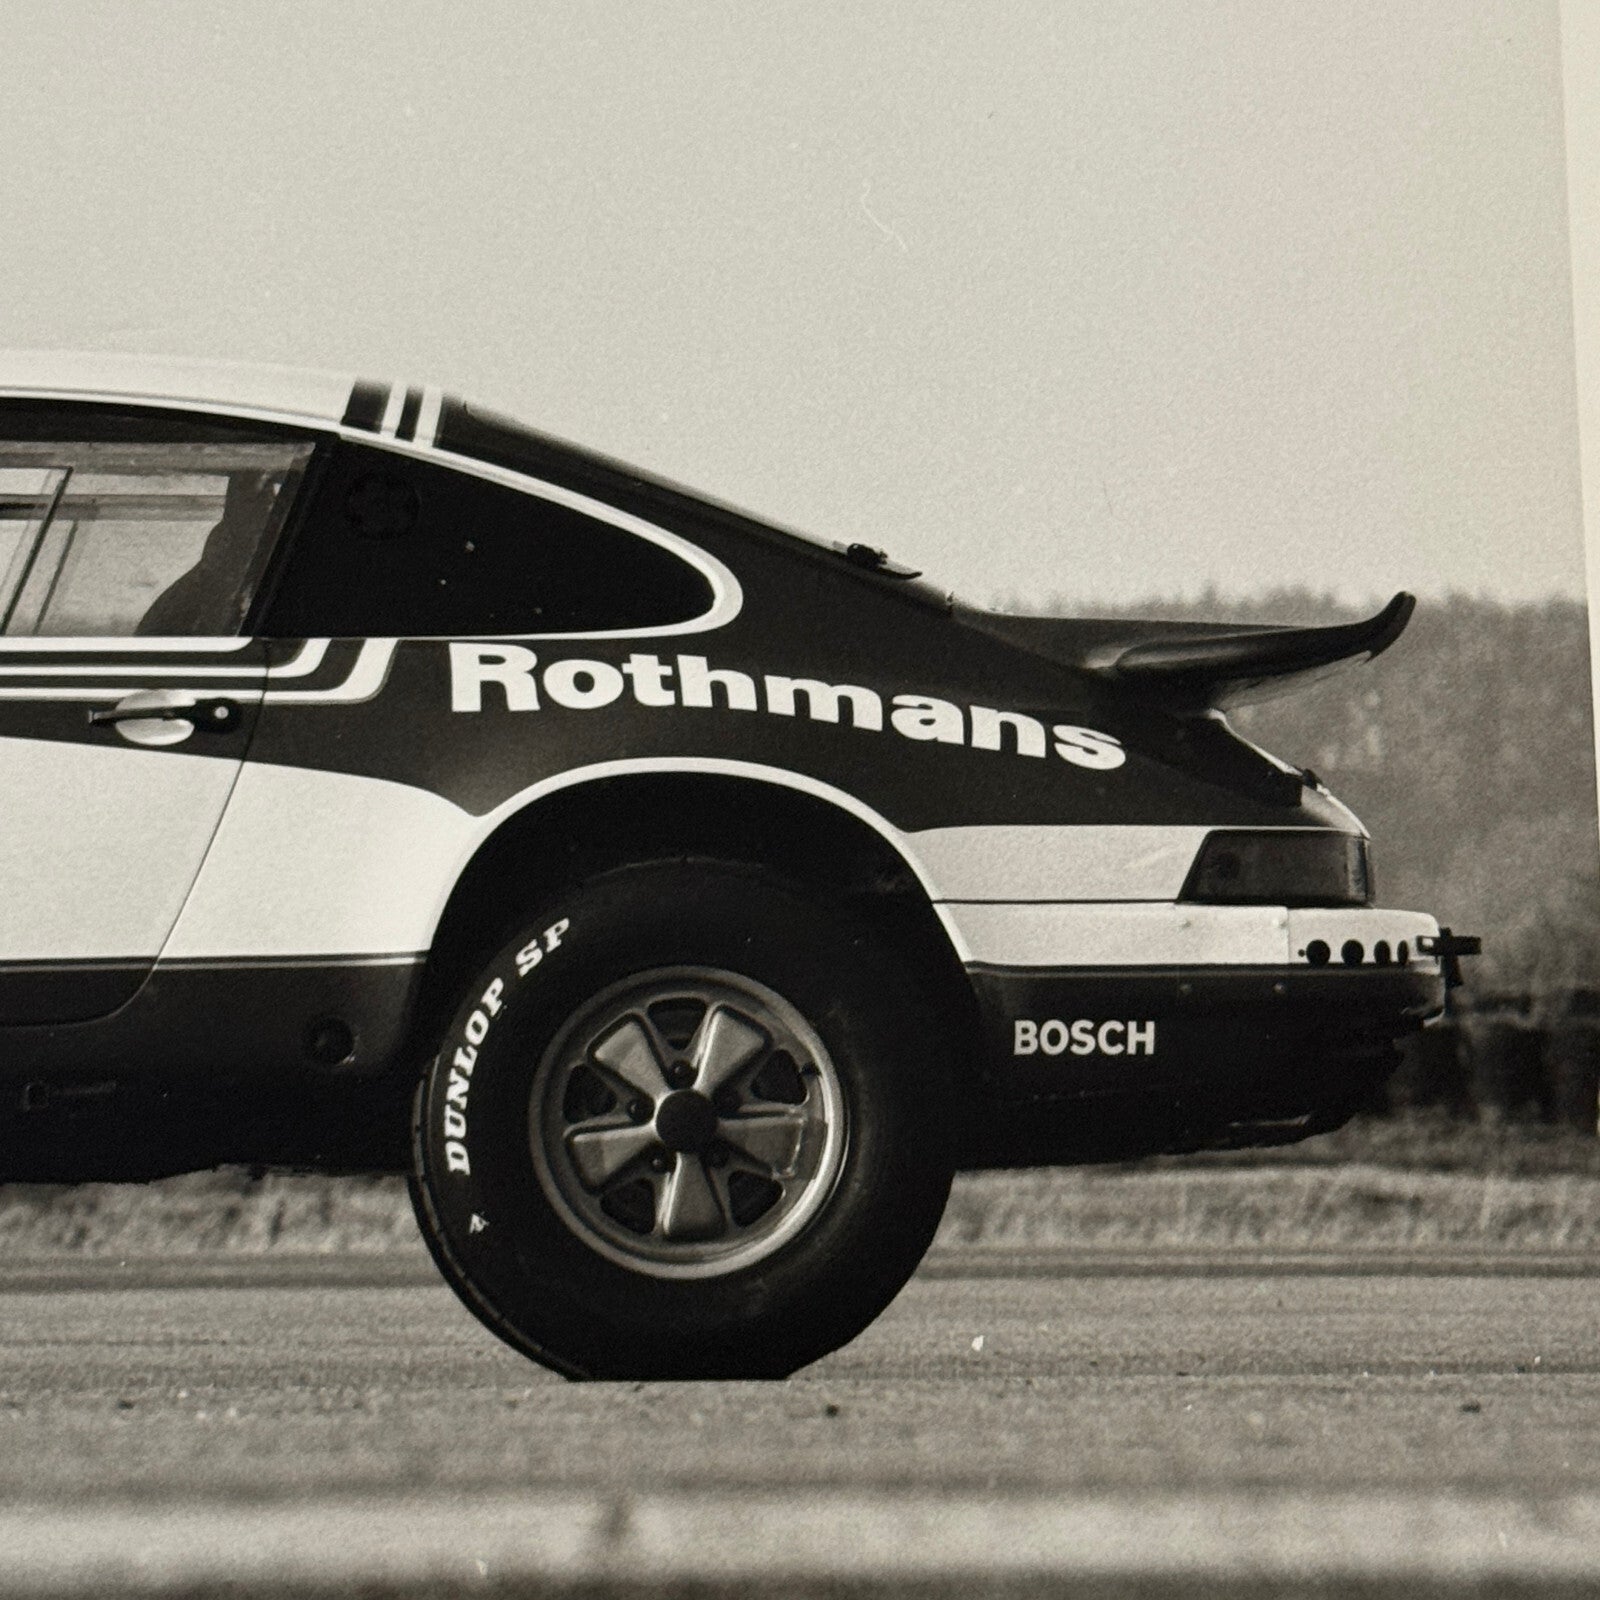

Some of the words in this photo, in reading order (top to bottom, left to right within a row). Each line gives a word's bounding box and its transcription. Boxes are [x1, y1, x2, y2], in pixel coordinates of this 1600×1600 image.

[448, 642, 1126, 770] Rothmans
[444, 977, 504, 1175] DUNLOP
[514, 918, 570, 977] SP
[1013, 1019, 1155, 1055] BOSCH
